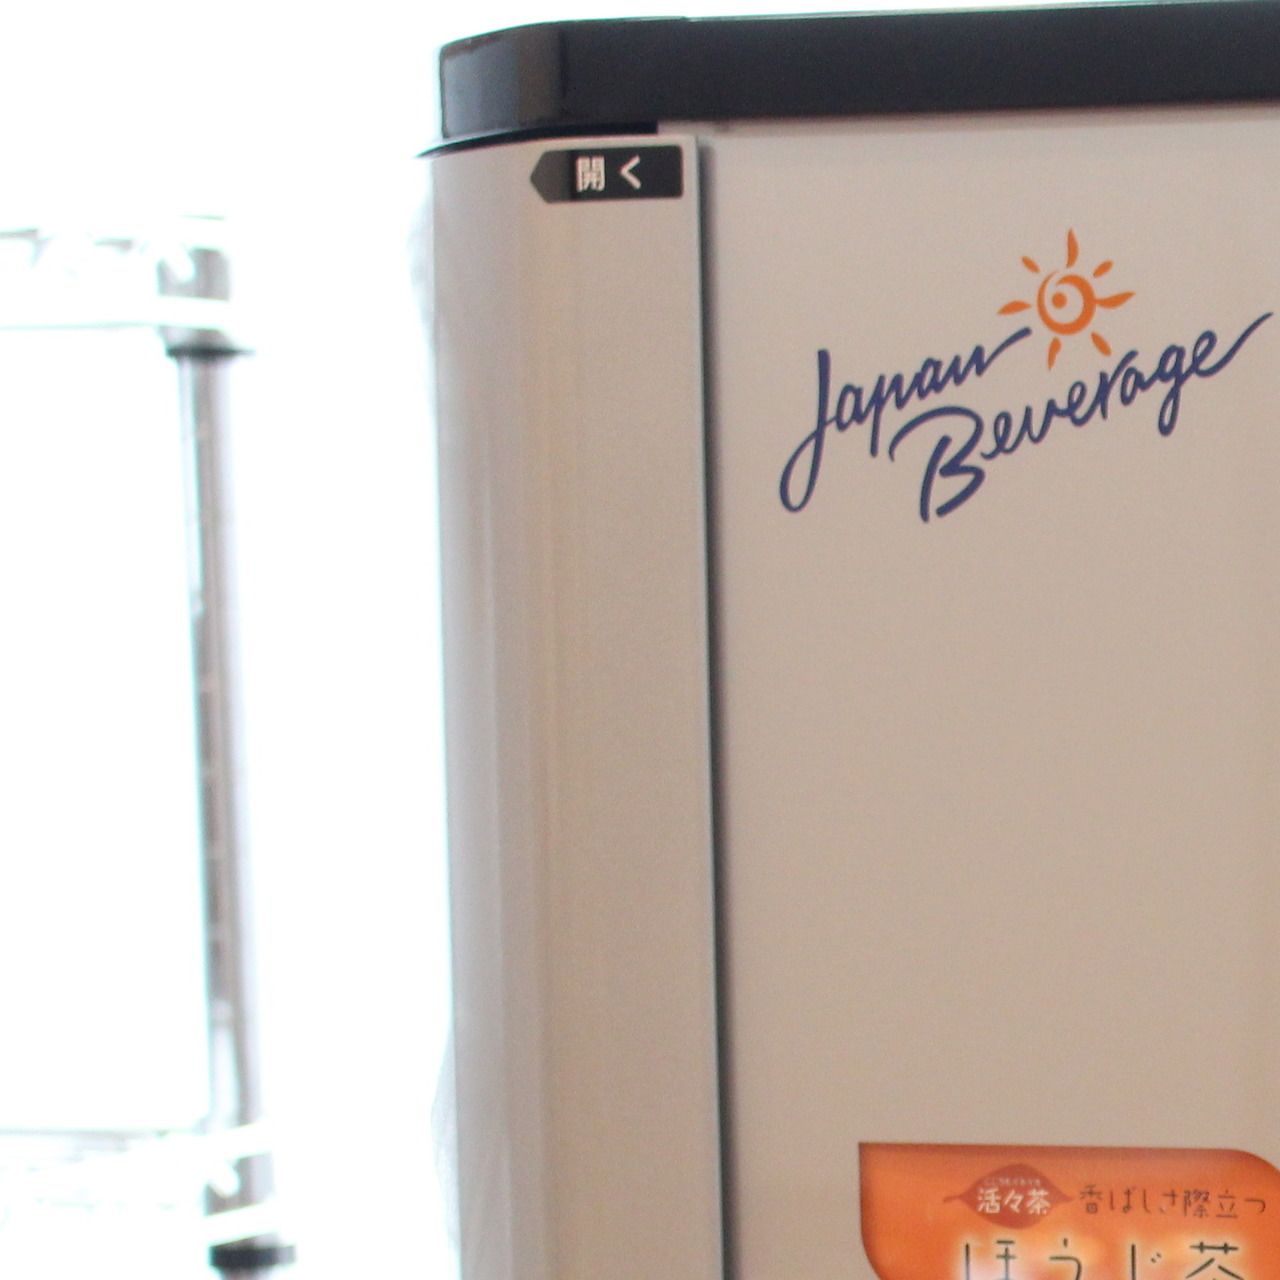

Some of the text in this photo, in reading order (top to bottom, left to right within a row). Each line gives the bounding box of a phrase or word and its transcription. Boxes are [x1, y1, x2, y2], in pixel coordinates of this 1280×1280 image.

[575, 154, 642, 192] 開く
[779, 326, 1032, 512] Japan
[888, 311, 1274, 523] Beverage
[976, 1187, 1051, 1215] 活々茶
[1079, 1184, 1266, 1219] 香ばしさ際立つ
